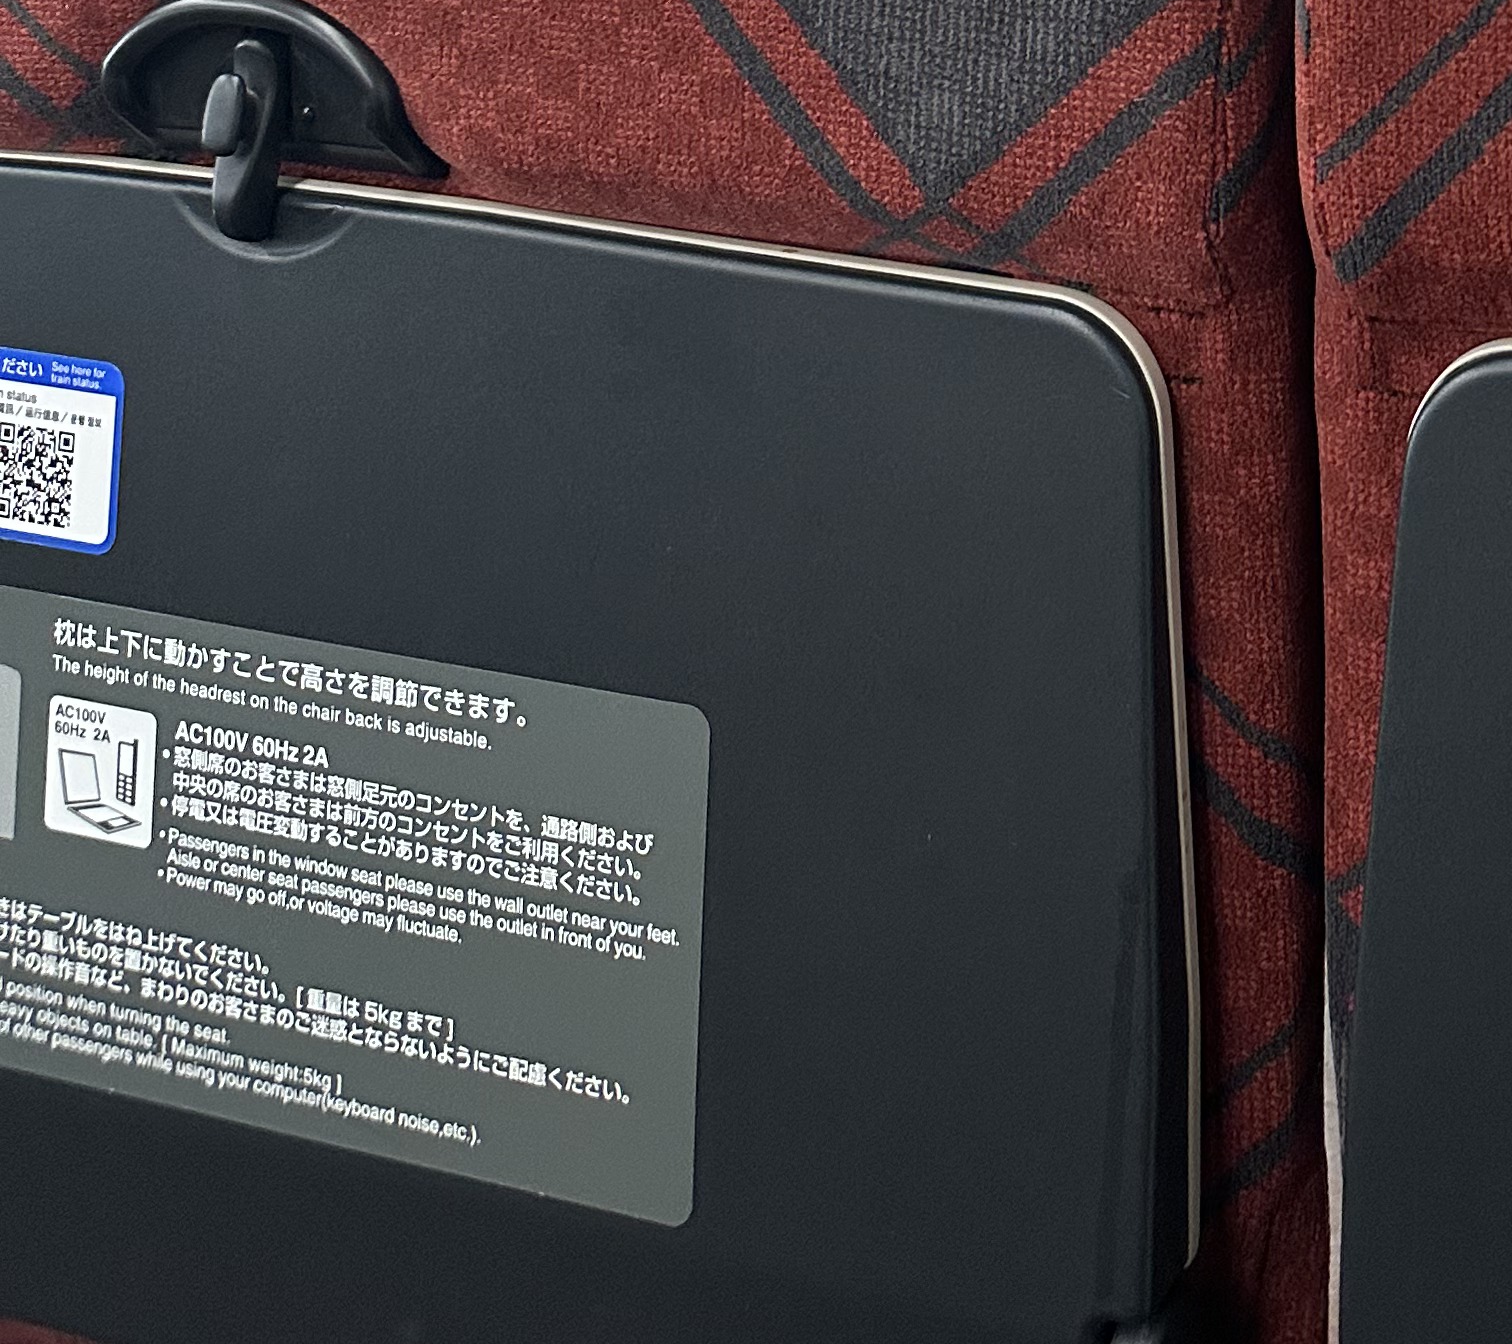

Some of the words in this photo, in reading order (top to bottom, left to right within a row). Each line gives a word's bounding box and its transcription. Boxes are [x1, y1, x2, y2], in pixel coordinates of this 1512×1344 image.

[51, 360, 69, 373] See
[52, 653, 81, 675] The
[84, 659, 130, 686] height
[133, 670, 149, 687] of
[152, 673, 176, 693] the
[179, 677, 246, 706] headrest
[249, 694, 269, 710] on
[273, 695, 298, 716] the
[302, 701, 342, 723] chair
[345, 707, 383, 731] back
[387, 715, 401, 734] is
[404, 721, 492, 751] adjustable.
[54, 720, 86, 739] 60Hz
[93, 727, 111, 744] 2A
[55, 703, 106, 725] AC100V
[174, 720, 249, 753] AC100V
[252, 735, 299, 763] 60Hz
[302, 744, 329, 769] 2A
[166, 847, 201, 870] Aisle
[203, 858, 220, 874] or
[219, 857, 266, 883] center
[267, 871, 299, 890] seat
[301, 878, 385, 908] passengers
[385, 890, 436, 918] please
[439, 905, 467, 926] use
[469, 908, 494, 930] the
[496, 917, 538, 939] outlet
[540, 922, 555, 942] in
[558, 925, 593, 950] front
[595, 935, 613, 953] of
[613, 940, 646, 961] you.
[166, 866, 212, 892] Power
[213, 880, 244, 903] may
[246, 886, 266, 906] go
[307, 899, 360, 925] voltage
[362, 910, 394, 933] may
[396, 913, 462, 944] fluctuate.
[167, 827, 250, 860] Passengers
[252, 844, 266, 864] in
[268, 848, 291, 869] the
[294, 854, 349, 880] window
[350, 867, 383, 887] seat
[384, 872, 434, 898] please
[436, 884, 464, 903] use
[467, 888, 491, 910] the
[494, 896, 524, 920] wall
[526, 902, 569, 924] outlet
[571, 911, 609, 932] near
[607, 919, 645, 939] your
[646, 922, 680, 947] feet.
[4, 981, 63, 1012] position
[66, 993, 106, 1017] when
[109, 1002, 162, 1035] turning
[164, 1014, 190, 1040] the
[193, 1023, 231, 1046] seat.
[35, 1008, 90, 1035] objects
[92, 1021, 112, 1039] on
[171, 1036, 244, 1069] Maximum
